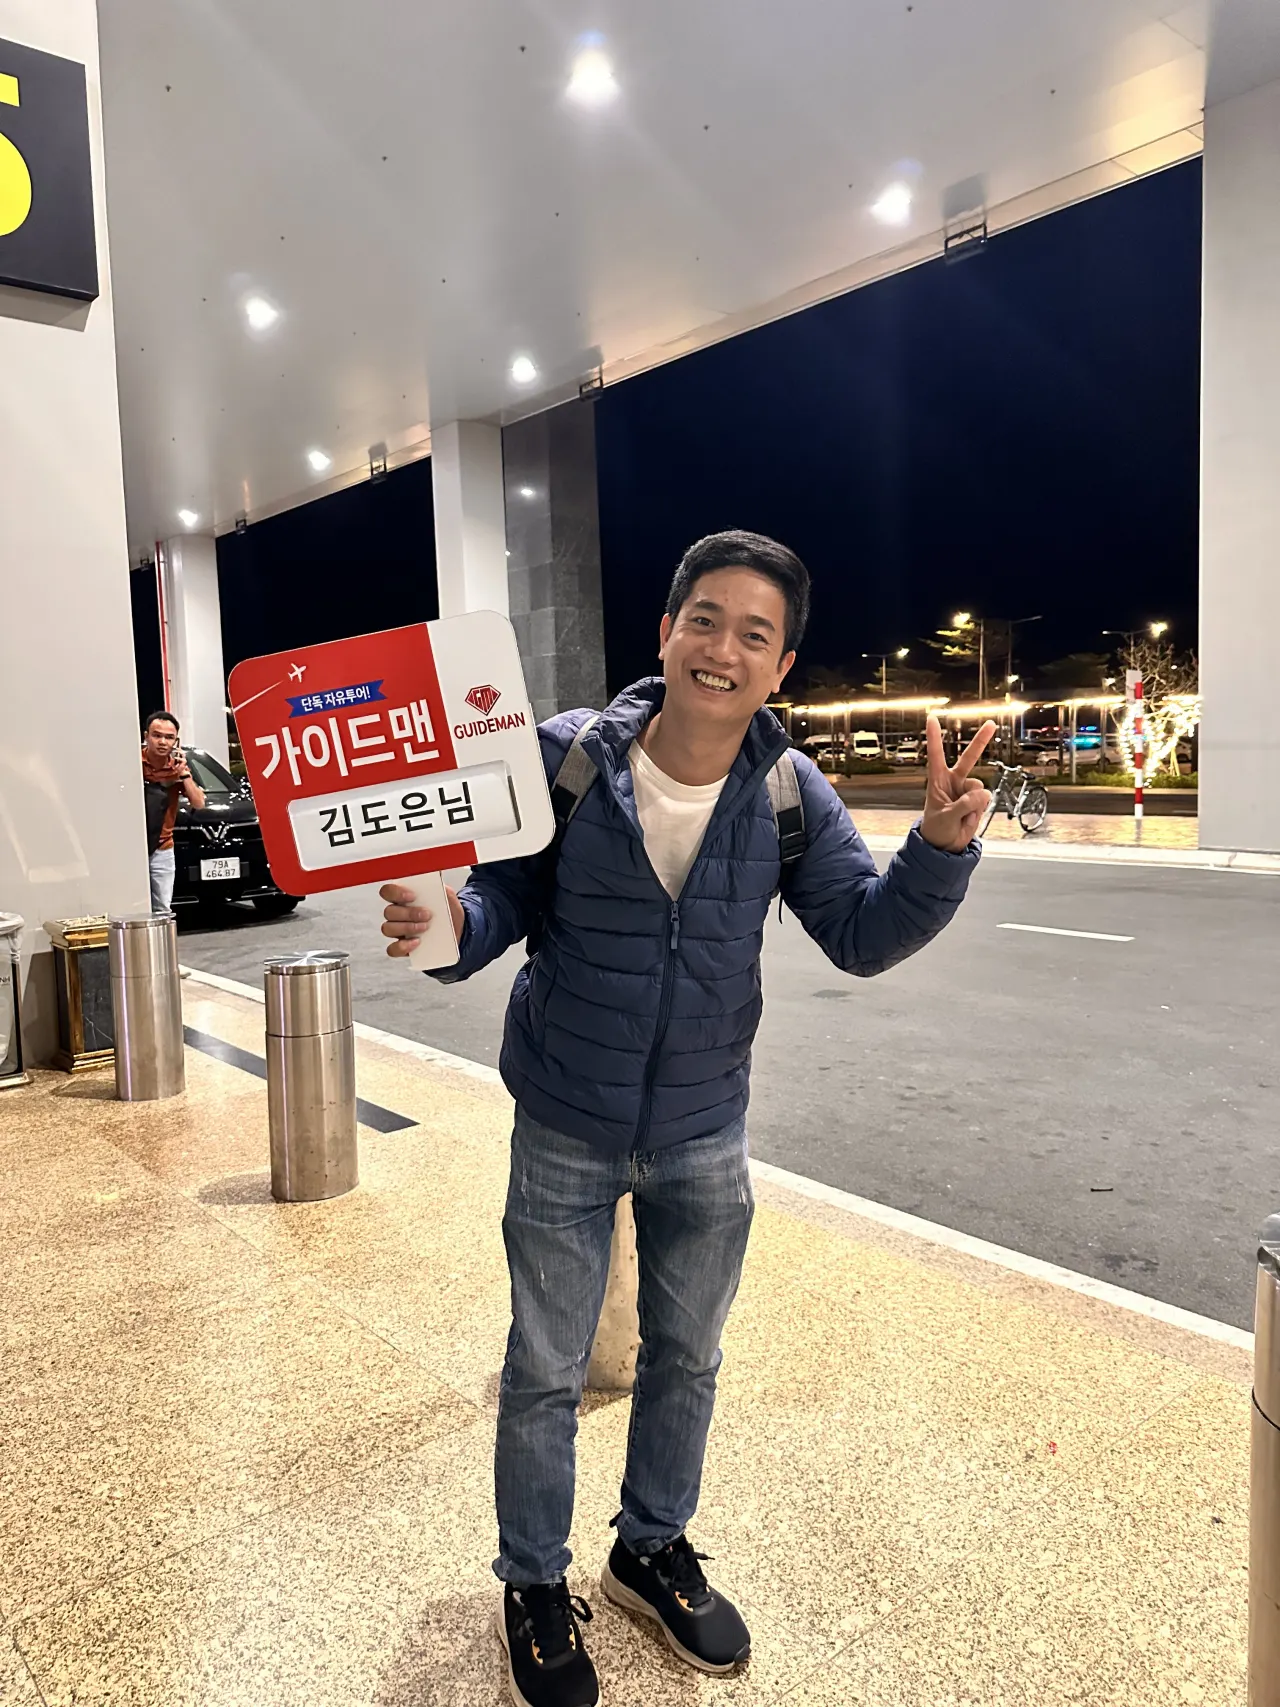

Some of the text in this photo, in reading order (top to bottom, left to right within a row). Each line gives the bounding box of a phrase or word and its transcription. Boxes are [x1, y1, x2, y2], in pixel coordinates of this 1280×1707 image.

[301, 685, 371, 712] 단독 자유투어!
[453, 711, 526, 740] GUIDEMAN
[254, 699, 440, 786] 가이드맨
[318, 781, 475, 848] 김도은님
[212, 860, 229, 869] 79A
